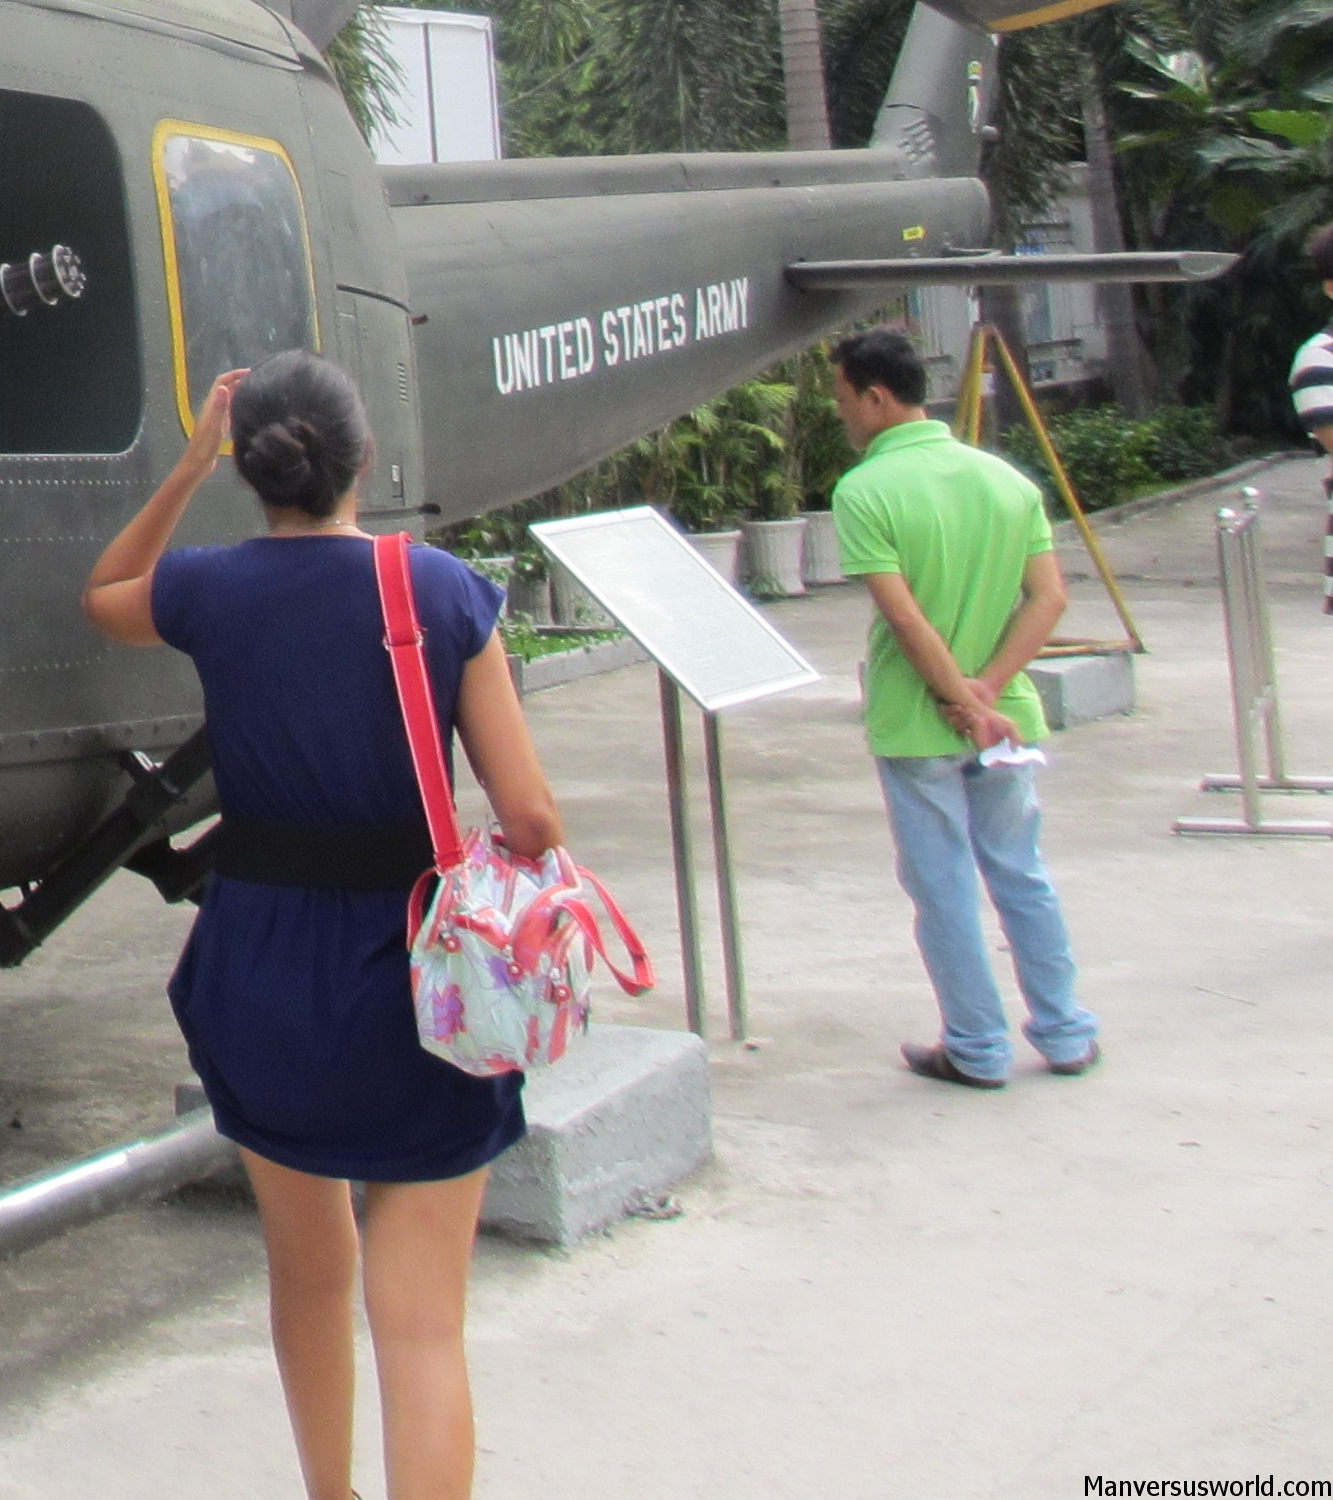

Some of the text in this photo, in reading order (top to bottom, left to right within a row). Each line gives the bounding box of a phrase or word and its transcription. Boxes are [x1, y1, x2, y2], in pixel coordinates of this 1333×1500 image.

[492, 276, 749, 395] UNITED STATES ARMY
